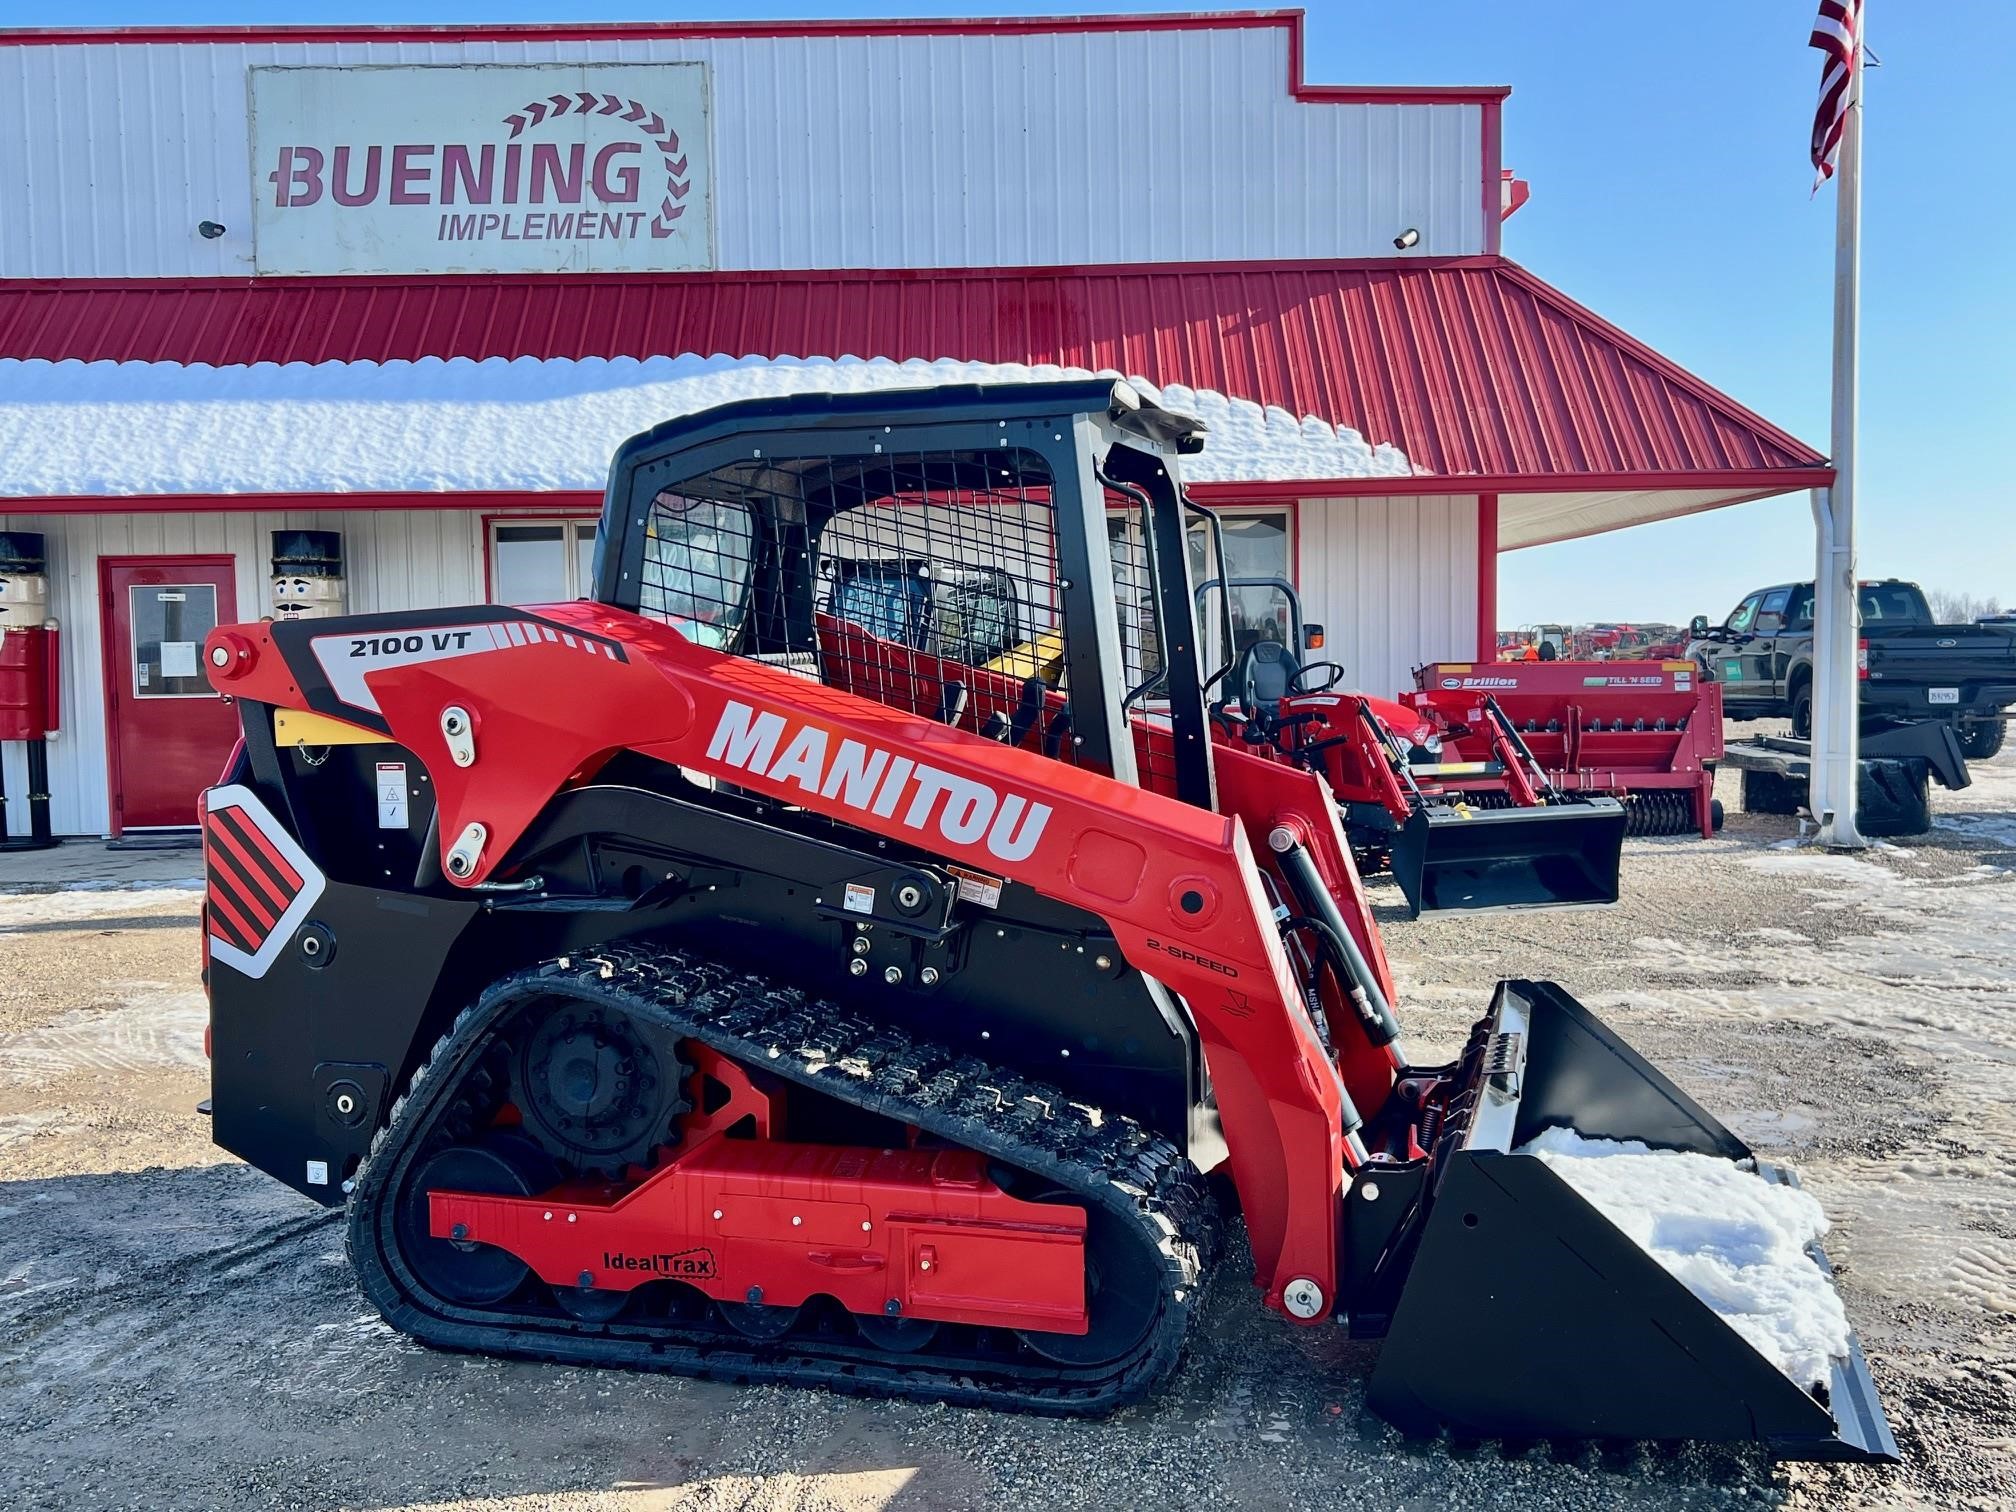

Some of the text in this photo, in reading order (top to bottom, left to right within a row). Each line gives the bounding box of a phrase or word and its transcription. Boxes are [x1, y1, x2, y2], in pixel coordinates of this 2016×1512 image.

[269, 142, 643, 208] BUENING
[438, 211, 647, 241] IMPLEMENT
[350, 631, 471, 657] 2100 VT
[1462, 677, 1517, 686] Brillion
[1609, 676, 1626, 684] TILL
[1640, 676, 1662, 684] SEED
[705, 699, 1054, 862] MANITOU
[1146, 938, 1238, 978] 2-SPEED
[603, 1251, 711, 1274] IdealTrax
